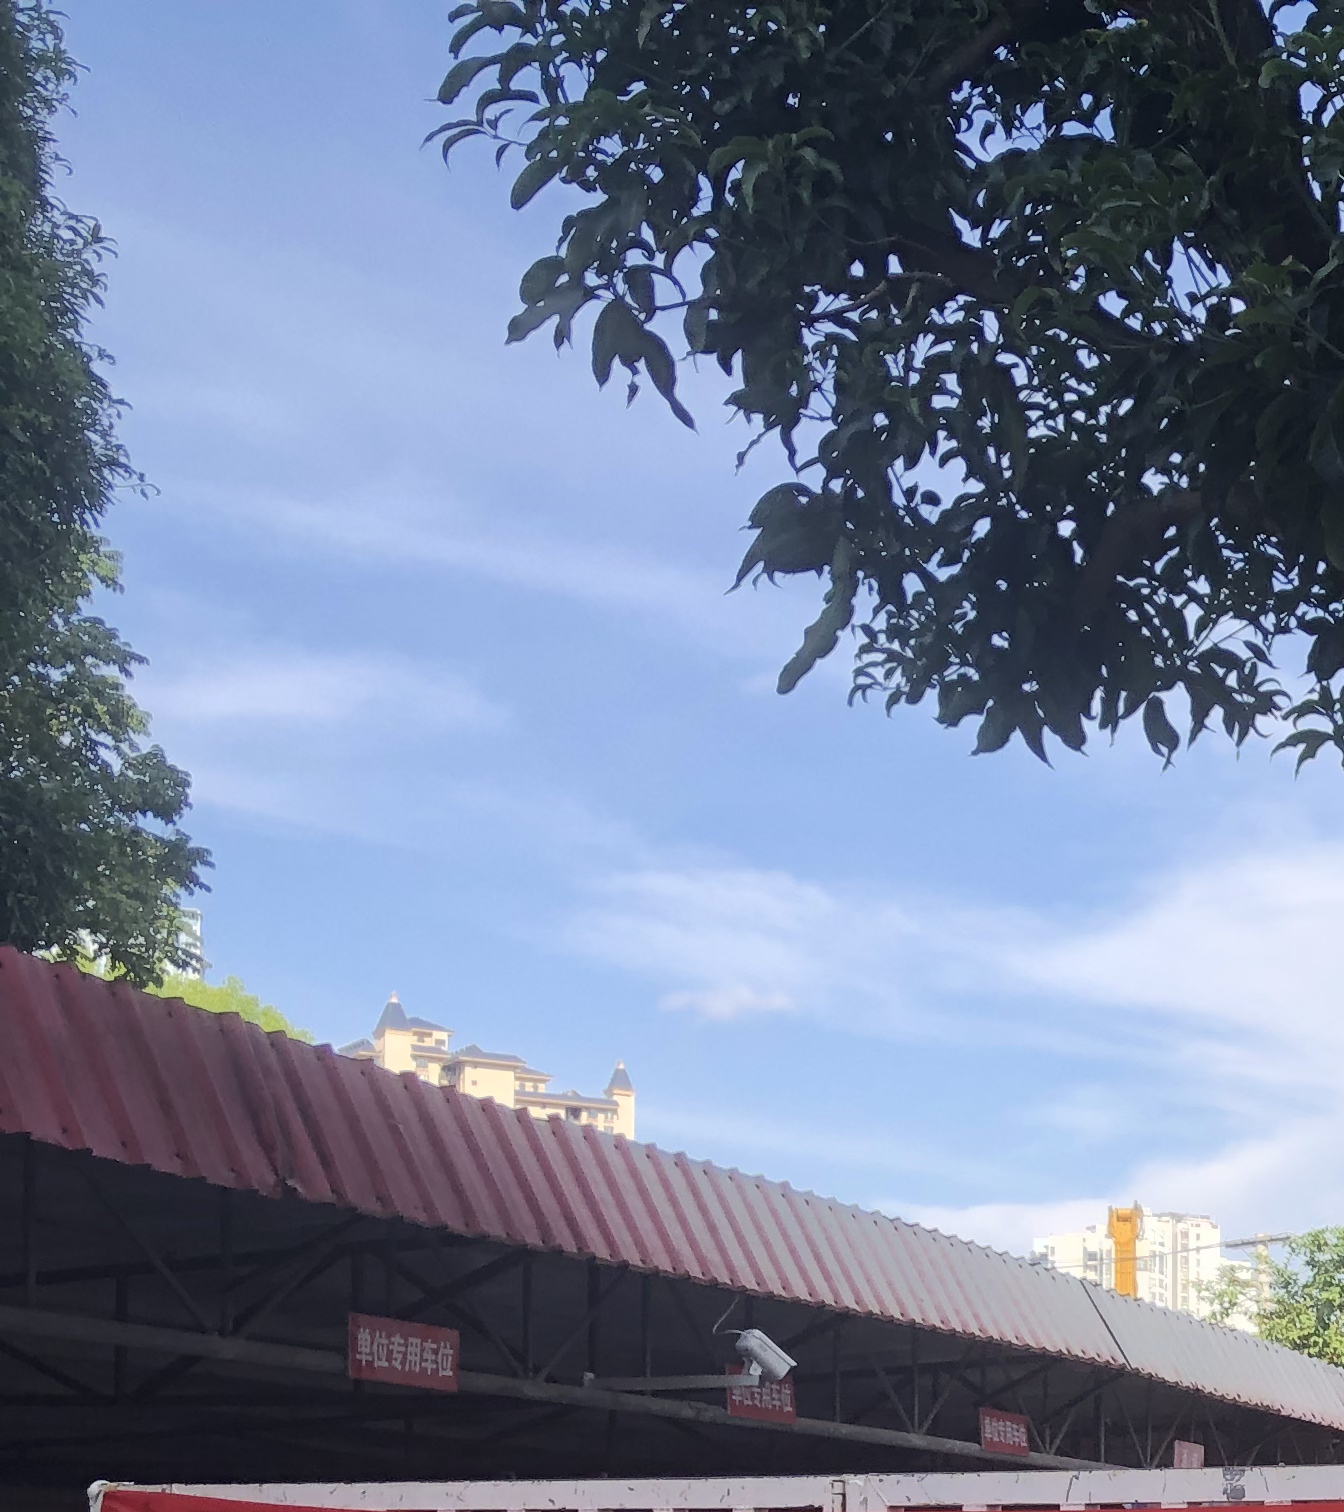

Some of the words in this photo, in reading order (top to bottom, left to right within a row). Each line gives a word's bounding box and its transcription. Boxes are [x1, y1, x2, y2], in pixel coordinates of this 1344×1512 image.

[355, 1327, 455, 1378] 单位专用车位
